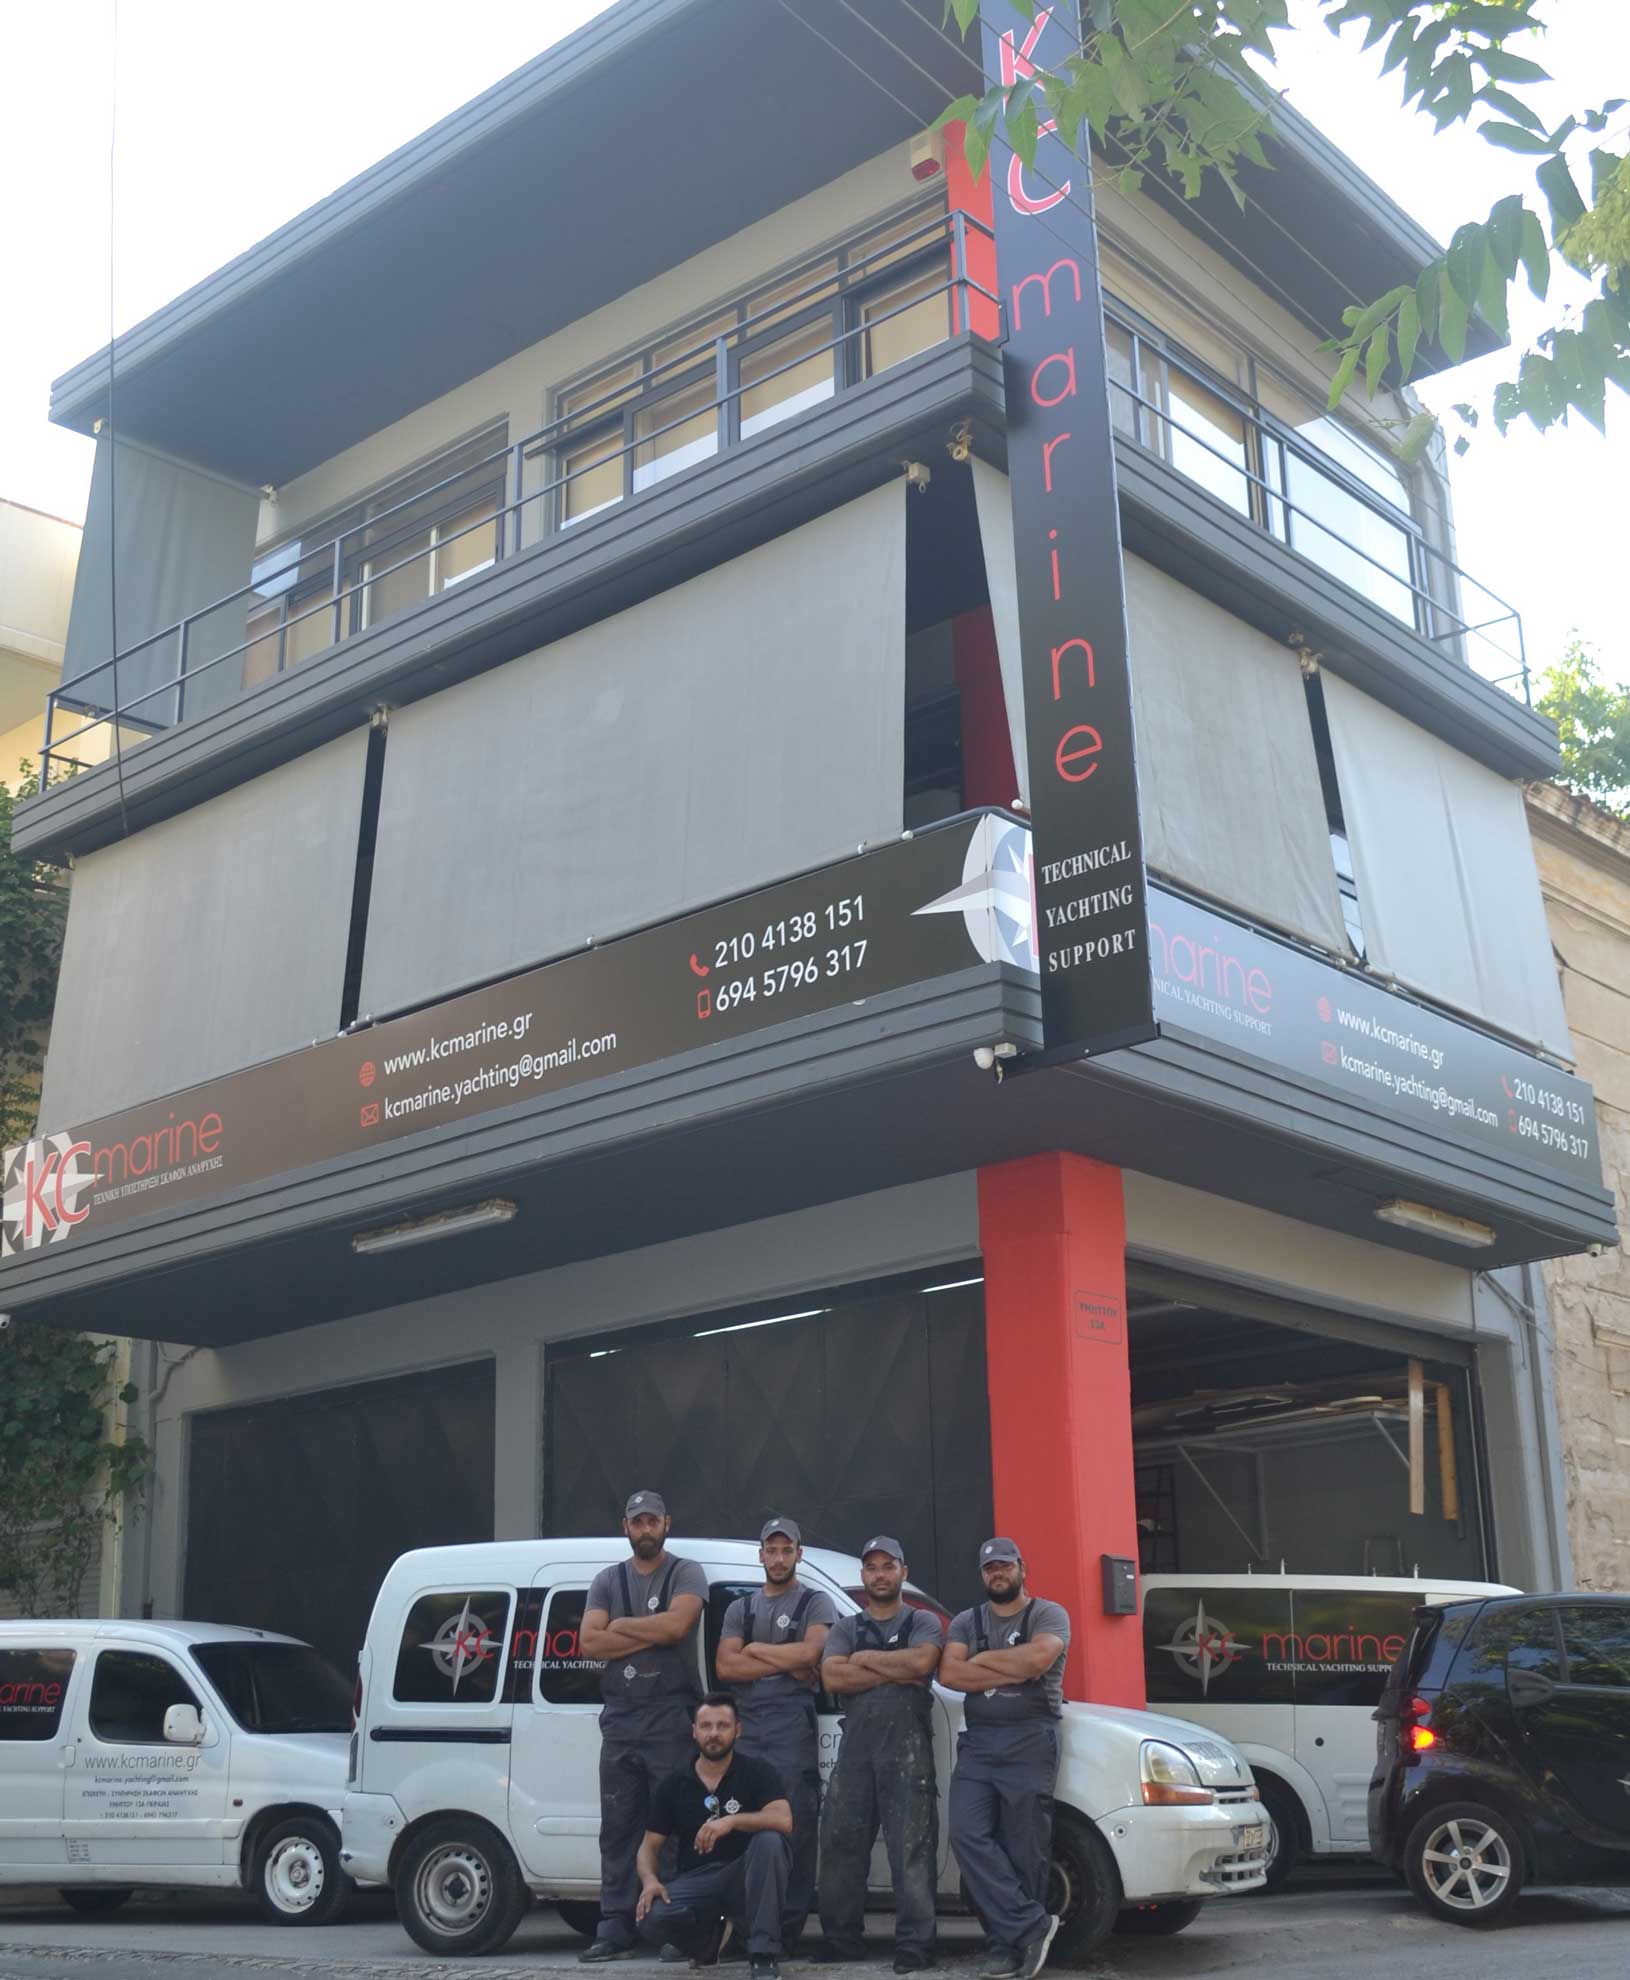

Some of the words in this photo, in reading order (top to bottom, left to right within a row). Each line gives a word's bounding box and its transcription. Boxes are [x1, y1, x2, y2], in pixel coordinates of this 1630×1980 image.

[1041, 841, 1131, 885] TECHNICAL
[1045, 885, 1133, 928] YACHTING
[714, 932, 755, 968] 210
[761, 911, 817, 951] 4138
[825, 895, 864, 930] 151
[1049, 929, 1136, 973] SUPPORT
[716, 976, 757, 1011] 694
[763, 956, 818, 997] 5796
[826, 940, 868, 977] 317
[1184, 990, 1232, 1021] YACHTING
[1232, 1010, 1273, 1037] SUPPORT
[384, 1011, 533, 1076] www.kcmarine.gr
[1337, 1008, 1444, 1069] www.kcmarine.gr
[384, 1032, 617, 1120] kcmarine.yachting@gmail.com
[1340, 1047, 1498, 1128] kcmarine.yachting@gmail.com
[1513, 1078, 1535, 1105] 210
[1538, 1087, 1564, 1117] 4138
[1567, 1101, 1584, 1125] 151
[1518, 1115, 1539, 1140] 694
[1541, 1122, 1567, 1151] 5796
[1570, 1134, 1588, 1159] 317
[23, 1141, 91, 1239] KC
[92, 1112, 224, 1188] marine
[454, 1629, 496, 1660] KC
[513, 1660, 561, 1669] TECHICAL
[562, 1660, 606, 1670] YACHTING
[1262, 1625, 1406, 1662] marine
[1319, 1664, 1366, 1672] YACHTING
[84, 1752, 201, 1772] www.kcmarine.gr
